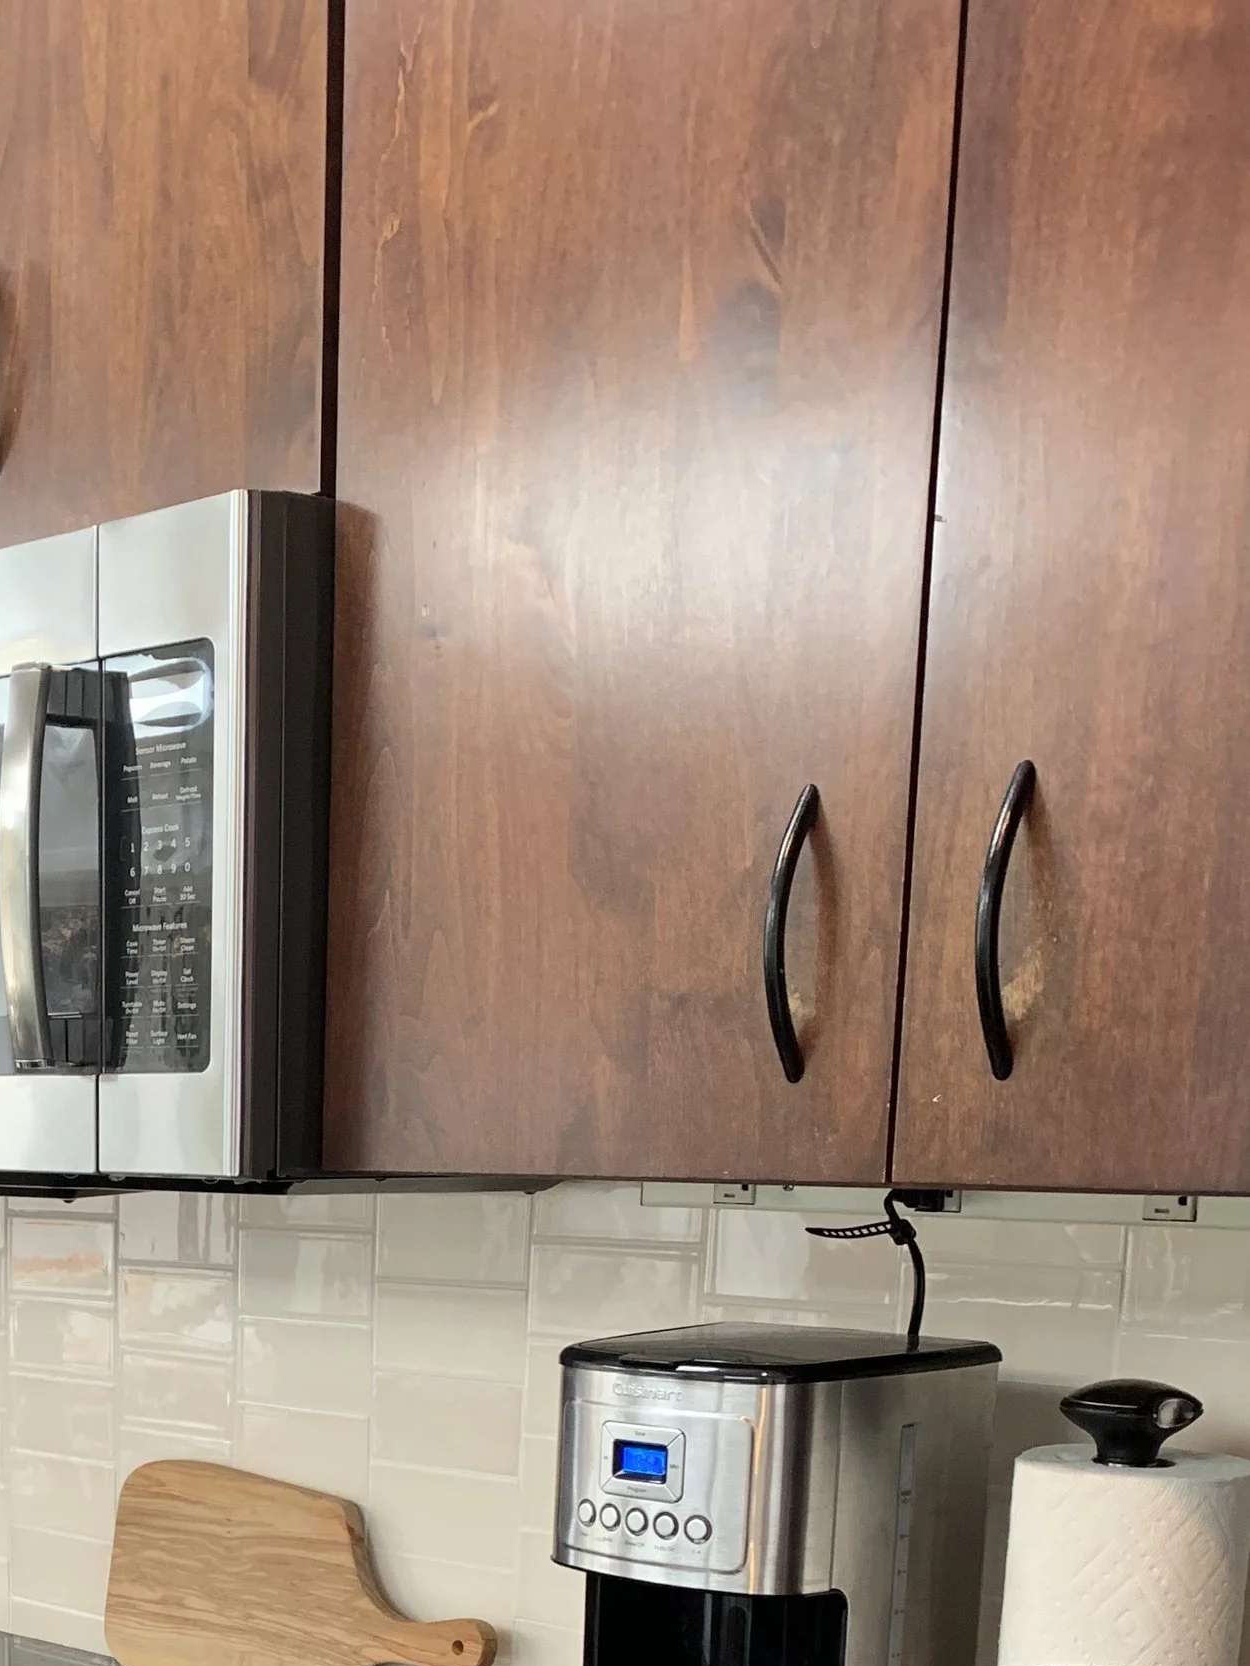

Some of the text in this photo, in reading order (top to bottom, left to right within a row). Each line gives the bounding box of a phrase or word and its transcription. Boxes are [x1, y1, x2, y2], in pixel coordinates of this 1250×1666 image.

[156, 742, 187, 752] Microwave
[142, 824, 179, 835] Express Cook
[131, 837, 190, 852] 1 2 3 4 5
[130, 862, 190, 877] 6 7 8 9 0
[132, 922, 187, 932] Microwave Features
[613, 1380, 683, 1401] Cuisinart
